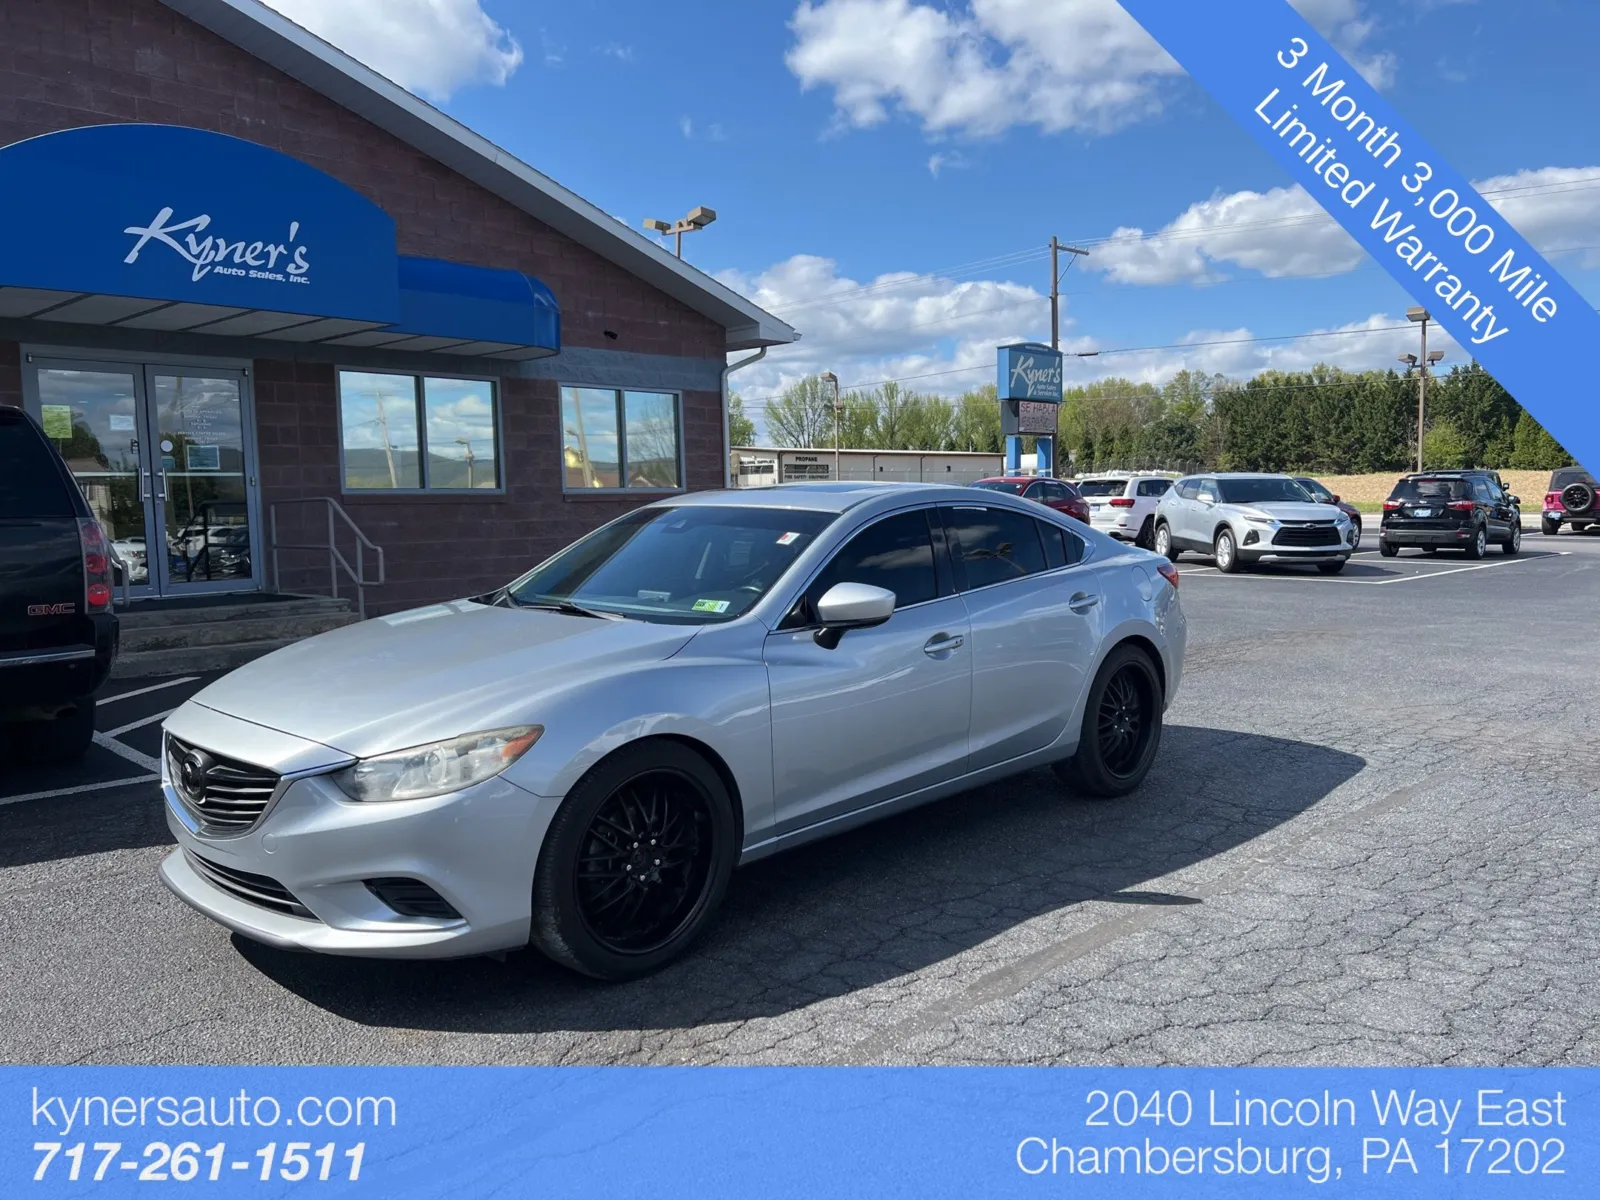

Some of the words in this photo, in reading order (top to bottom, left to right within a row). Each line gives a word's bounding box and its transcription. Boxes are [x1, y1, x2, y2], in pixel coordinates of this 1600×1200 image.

[123, 206, 310, 282] Kyner's
[213, 265, 246, 276] Auto
[248, 269, 286, 282] Sales,
[289, 274, 310, 284] Inc.
[1010, 354, 1061, 398] Kyner's
[1021, 402, 1031, 412] SE
[1033, 403, 1056, 415] HABLA
[28, 602, 75, 615] GMC
